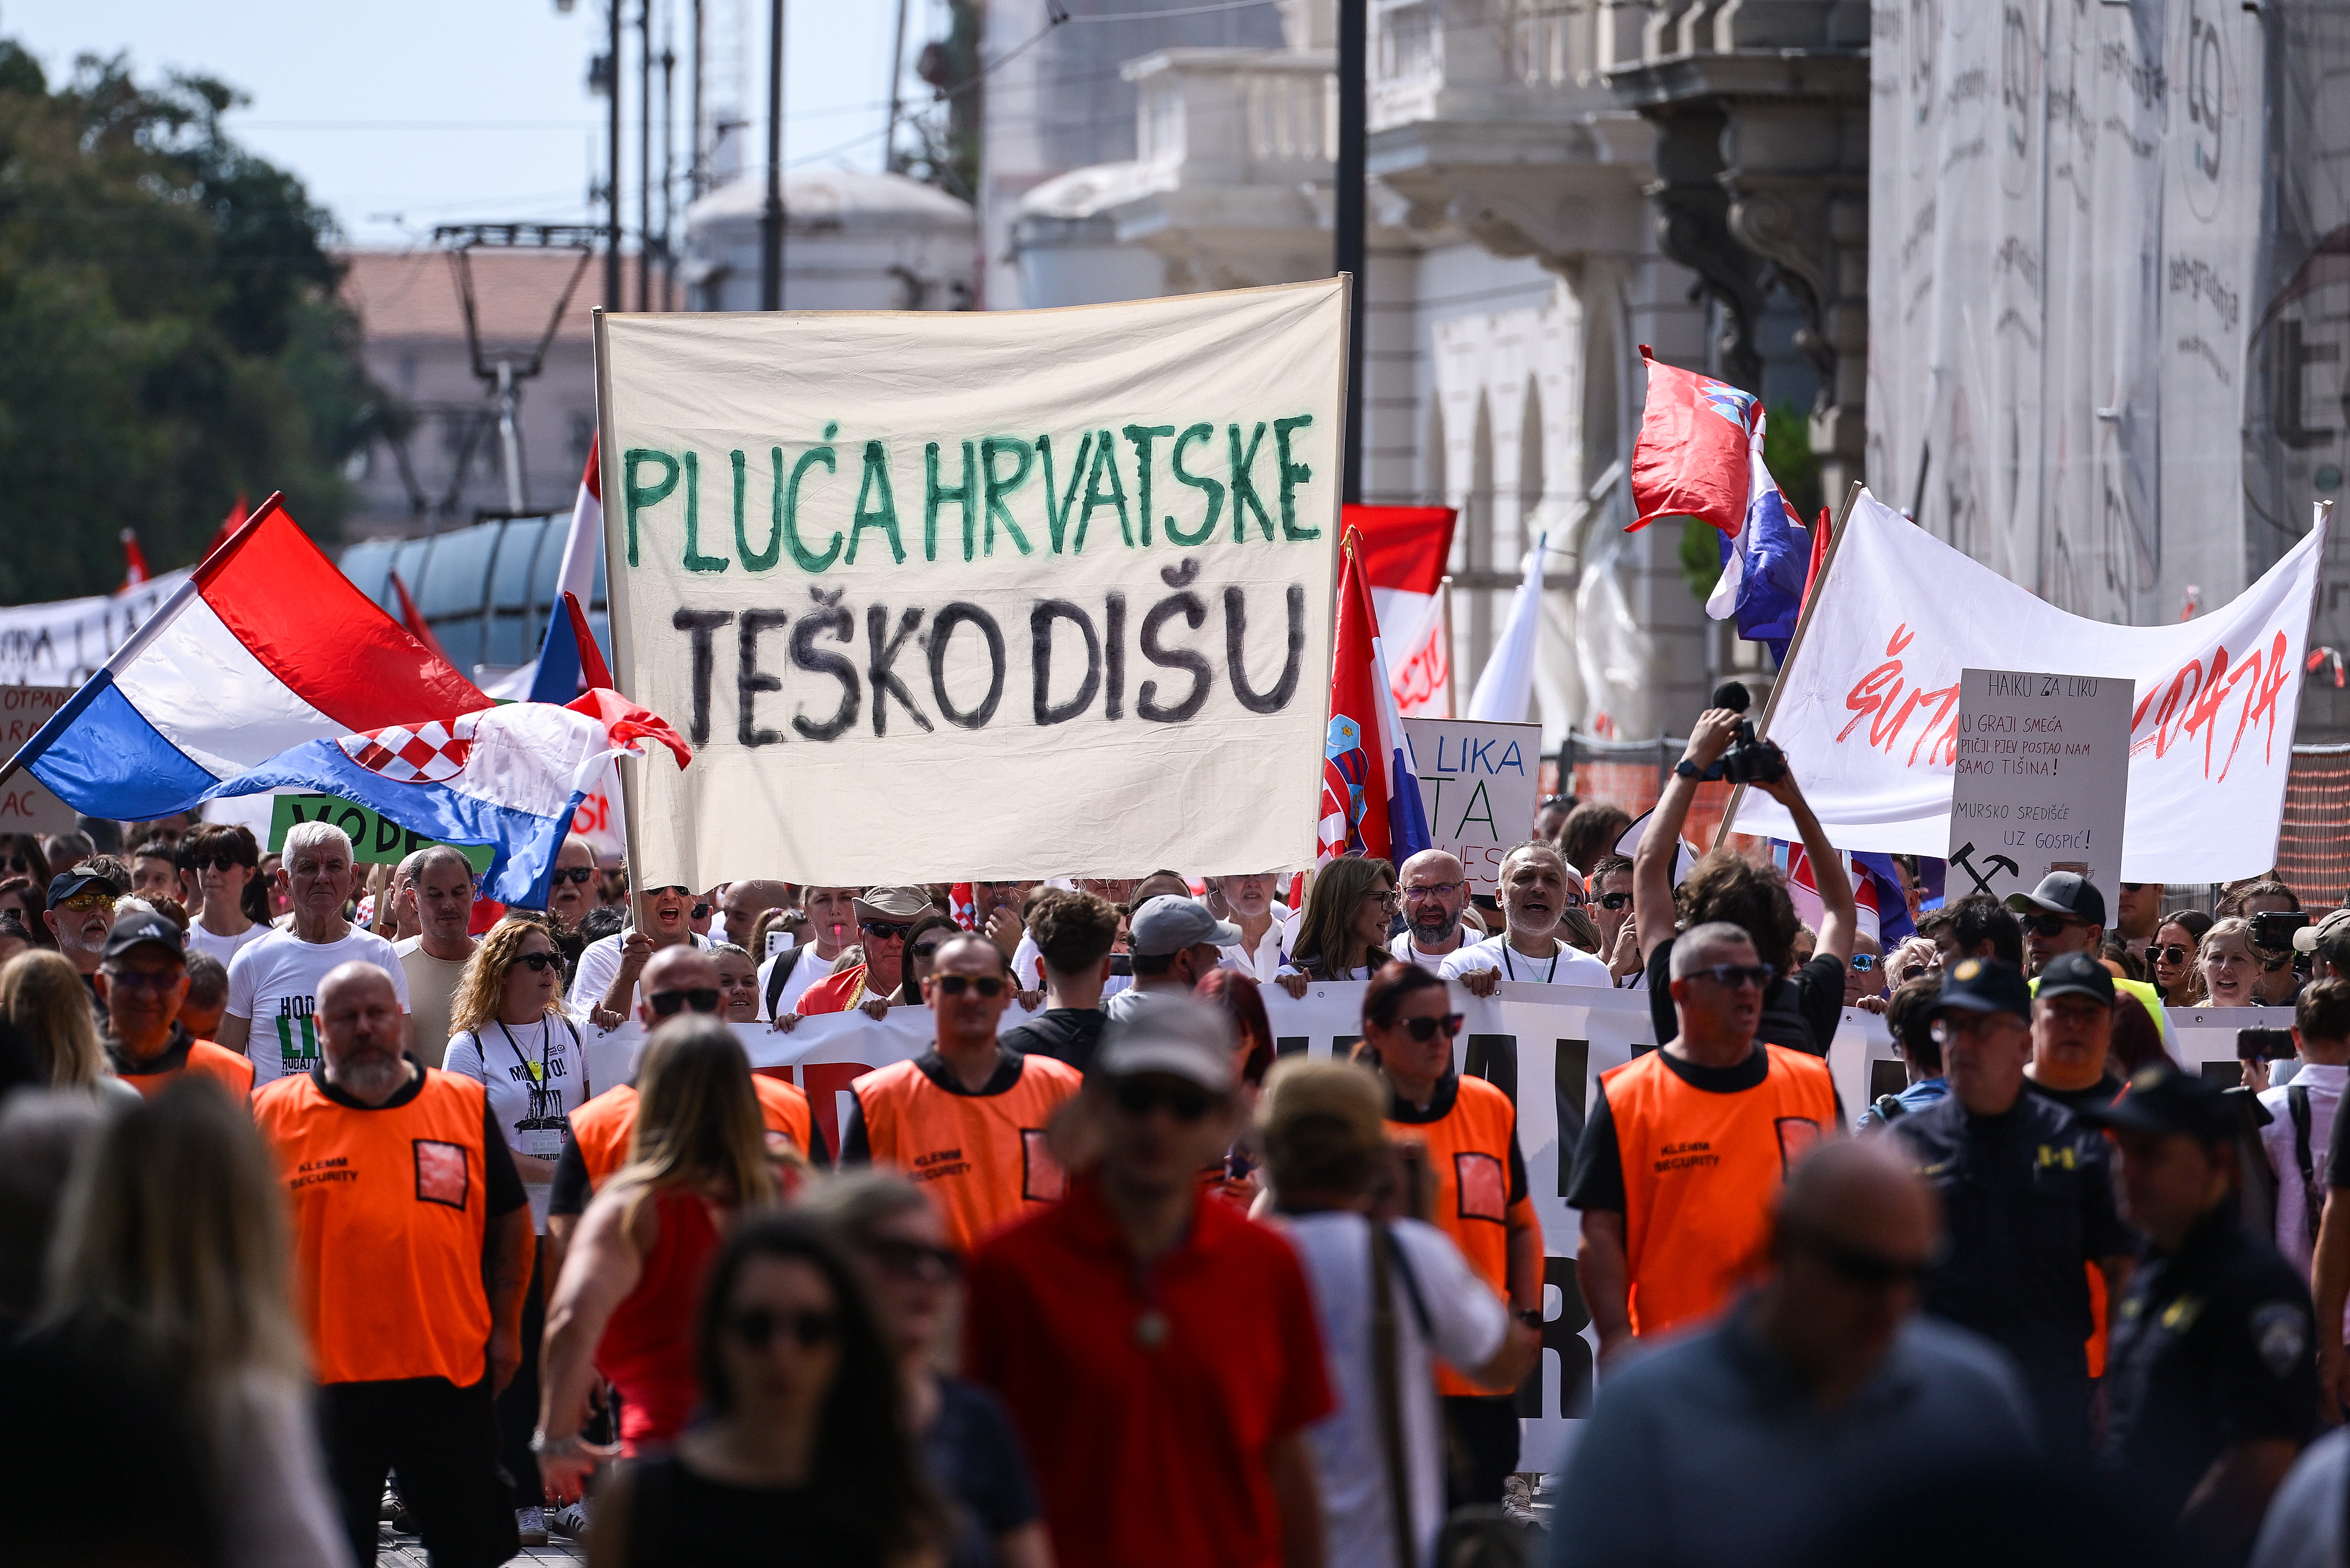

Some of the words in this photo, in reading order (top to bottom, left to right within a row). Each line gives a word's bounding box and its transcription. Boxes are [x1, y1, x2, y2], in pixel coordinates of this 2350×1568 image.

[625, 424, 907, 572] PLUĆA
[925, 415, 1320, 562] HRVATSKE
[673, 585, 1006, 746] TEŠKO
[1030, 558, 1302, 726] DIŠU
[1989, 673, 2032, 697] HAIKU
[2040, 677, 2060, 696] ZA
[2068, 677, 2097, 697] LIKU
[1962, 714, 1971, 733] U
[1978, 714, 2016, 733] GRAJI
[2023, 715, 2063, 733] SMEĆA
[1437, 736, 1525, 776] LIKA
[1961, 737, 1989, 754] PTIČJI
[1995, 740, 2018, 754] PJEV
[2022, 741, 2061, 754] POSTAO
[2065, 744, 2090, 756] NAM
[1957, 758, 1993, 774] SAMO
[1954, 803, 2009, 818] MURSKO
[2017, 803, 2069, 820] SREDIŠĆE
[2004, 830, 2025, 846] UZ
[281, 995, 315, 1020] HOD
[1661, 1141, 1710, 1156] KLEMM
[1654, 1155, 1719, 1173] SECURITY
[291, 1170, 358, 1190] SECURITY
